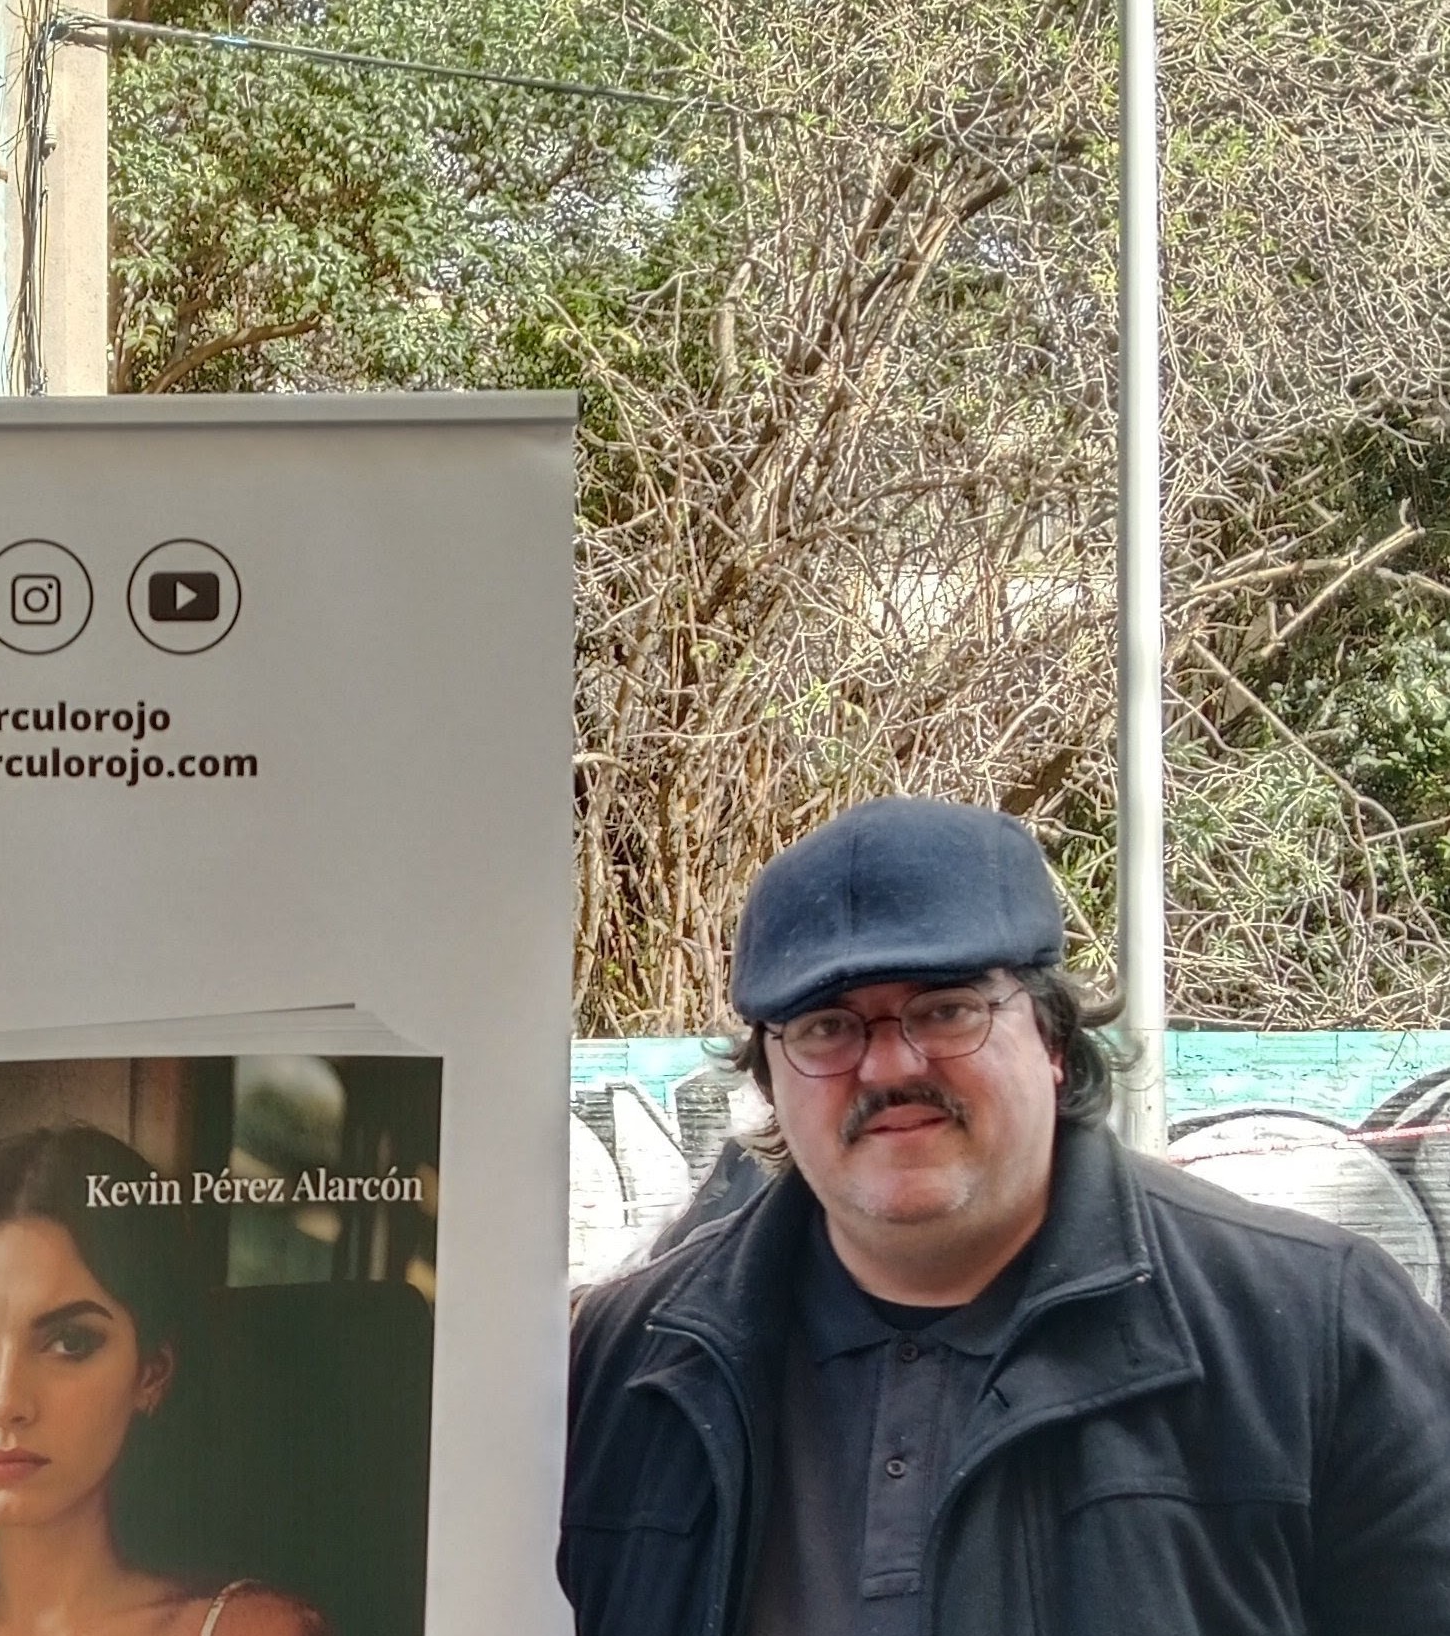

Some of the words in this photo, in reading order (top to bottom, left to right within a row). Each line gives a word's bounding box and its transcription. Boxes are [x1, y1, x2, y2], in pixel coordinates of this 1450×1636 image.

[86, 1172, 181, 1207] Kevin
[192, 1168, 285, 1204] Pérez
[291, 1166, 424, 1202] Alarcón
